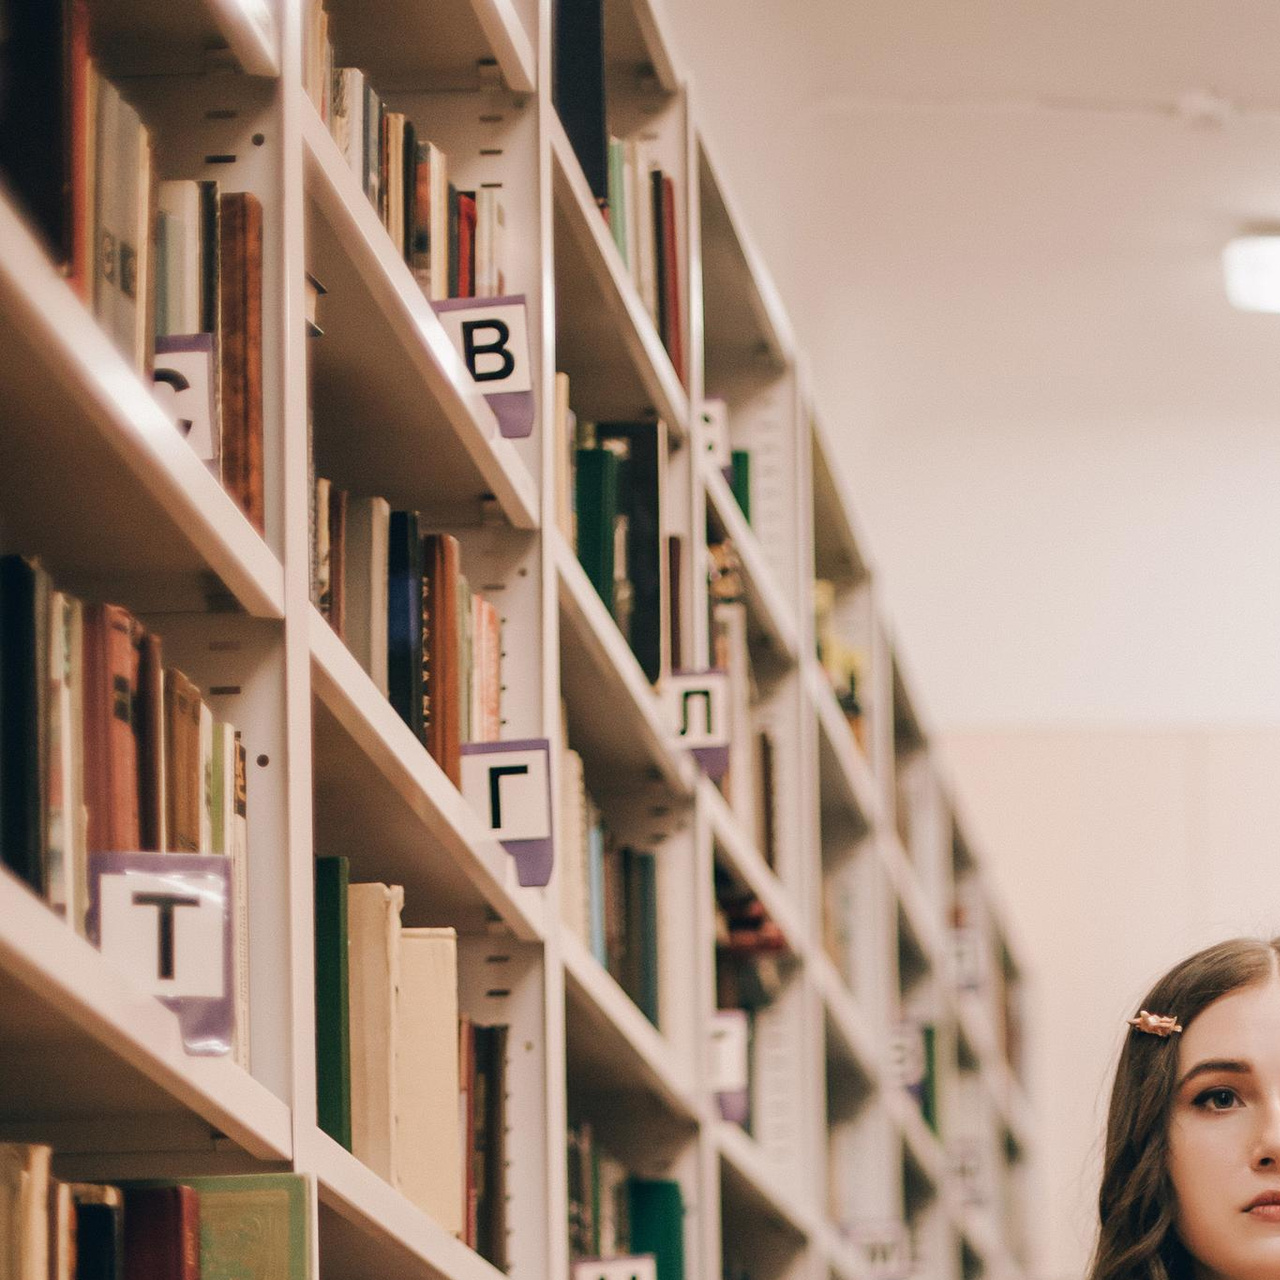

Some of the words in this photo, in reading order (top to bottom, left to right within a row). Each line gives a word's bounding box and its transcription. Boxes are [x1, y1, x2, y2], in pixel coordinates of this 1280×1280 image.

[461, 318, 516, 382] В
[488, 764, 529, 830] Г
[131, 890, 202, 981] Т
